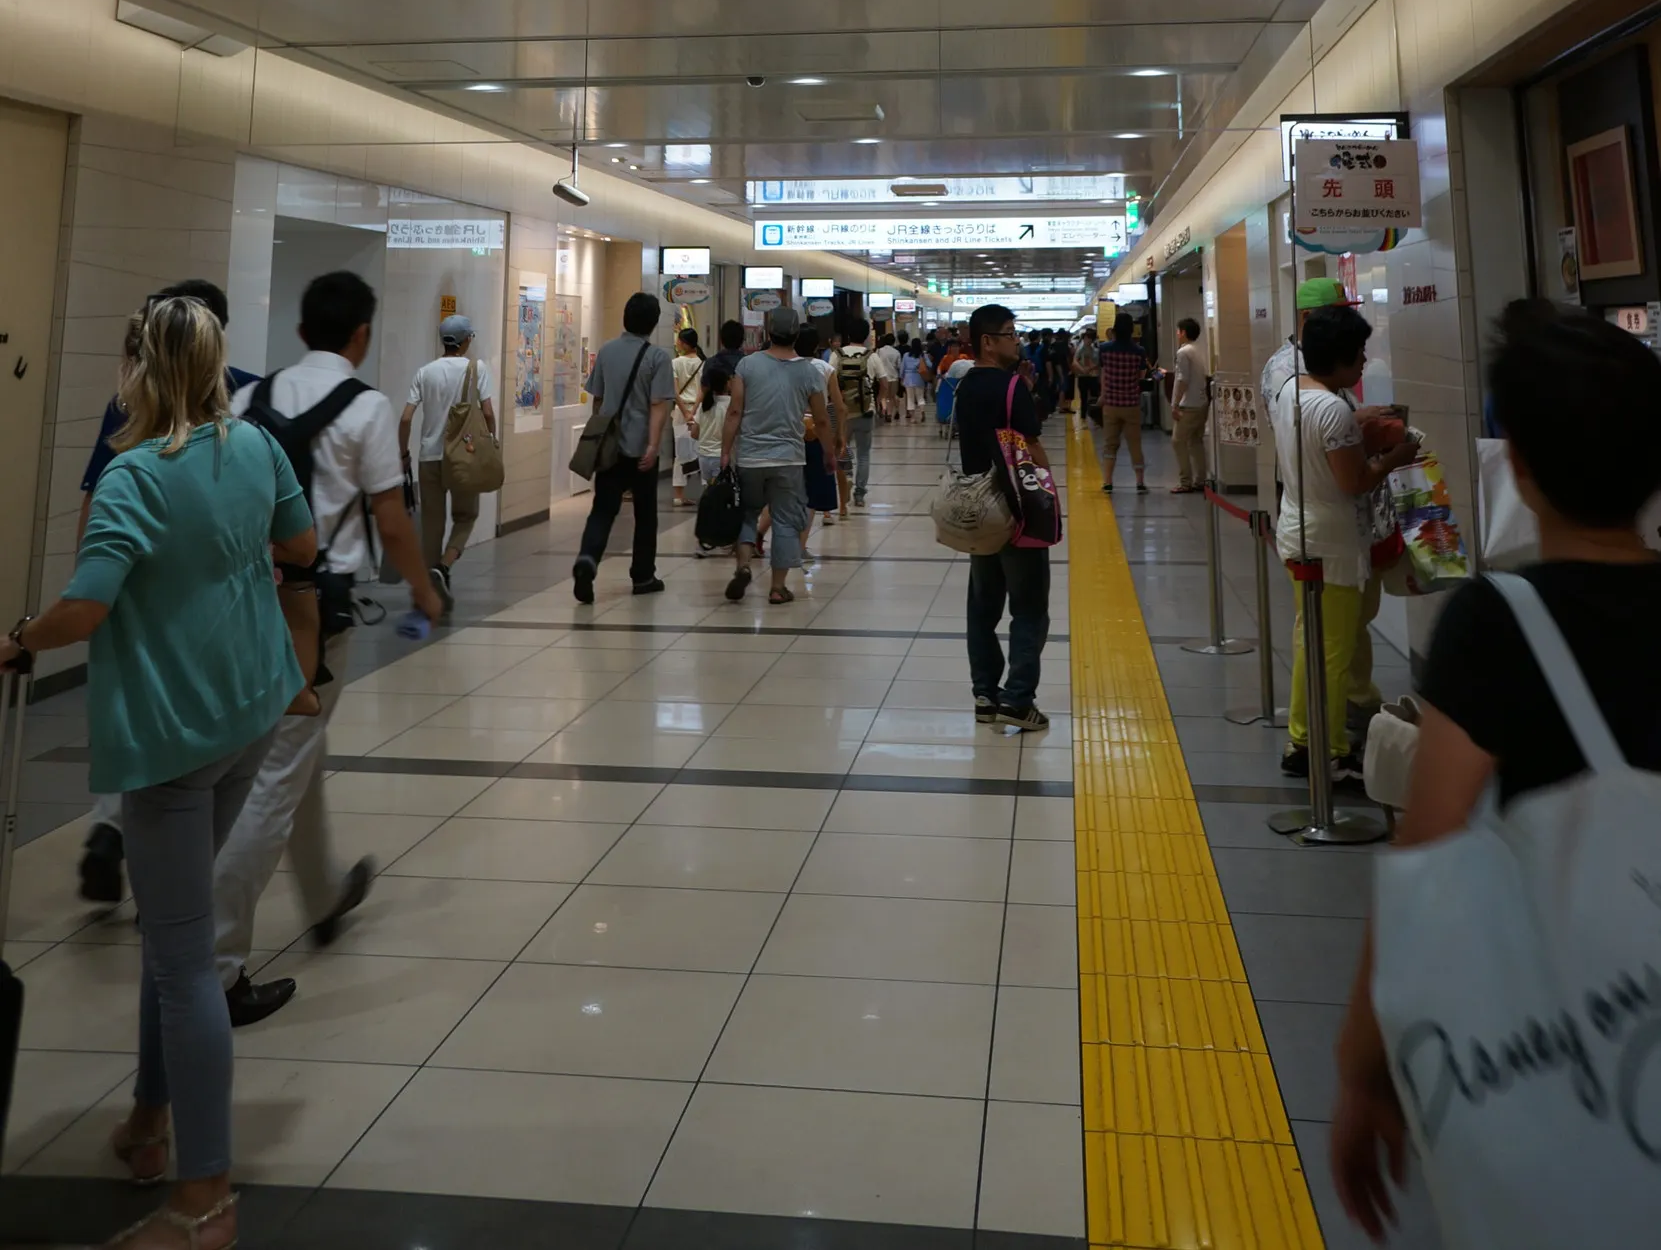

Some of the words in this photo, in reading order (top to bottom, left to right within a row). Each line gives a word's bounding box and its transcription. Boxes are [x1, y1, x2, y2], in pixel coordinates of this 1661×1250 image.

[887, 223, 996, 235] JR全線きっぷうりば
